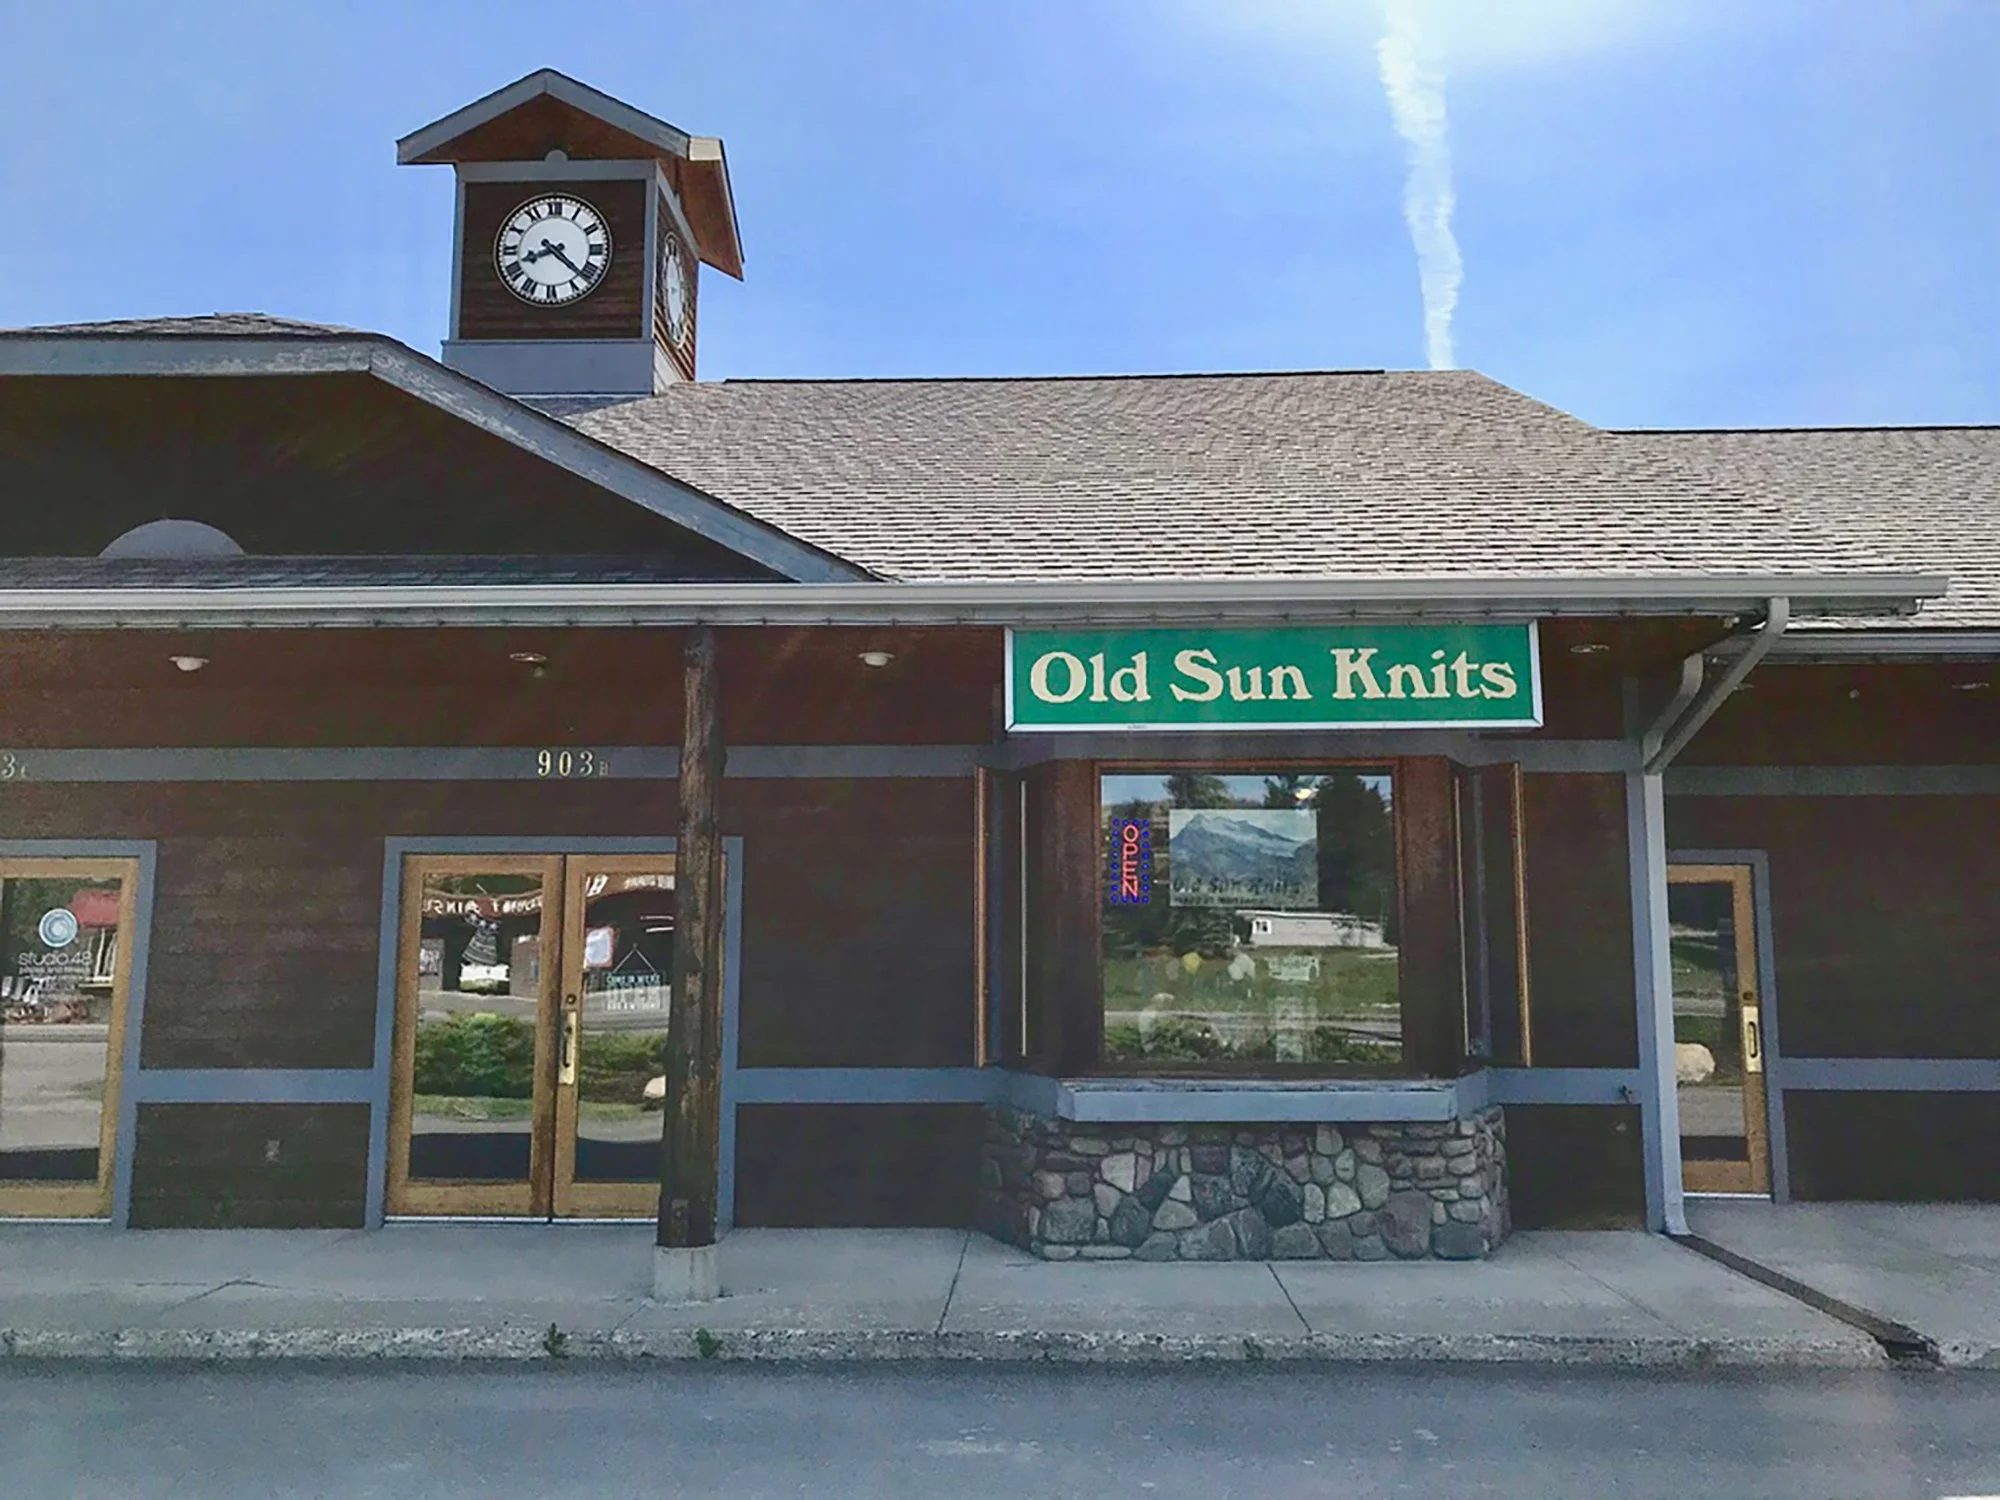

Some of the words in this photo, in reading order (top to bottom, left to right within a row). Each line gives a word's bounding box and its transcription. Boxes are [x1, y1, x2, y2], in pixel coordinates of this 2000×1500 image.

[1030, 651, 1151, 703] Old
[1169, 648, 1313, 701] Sun
[1330, 647, 1517, 700] Knits
[1122, 824, 1139, 898] OPEN
